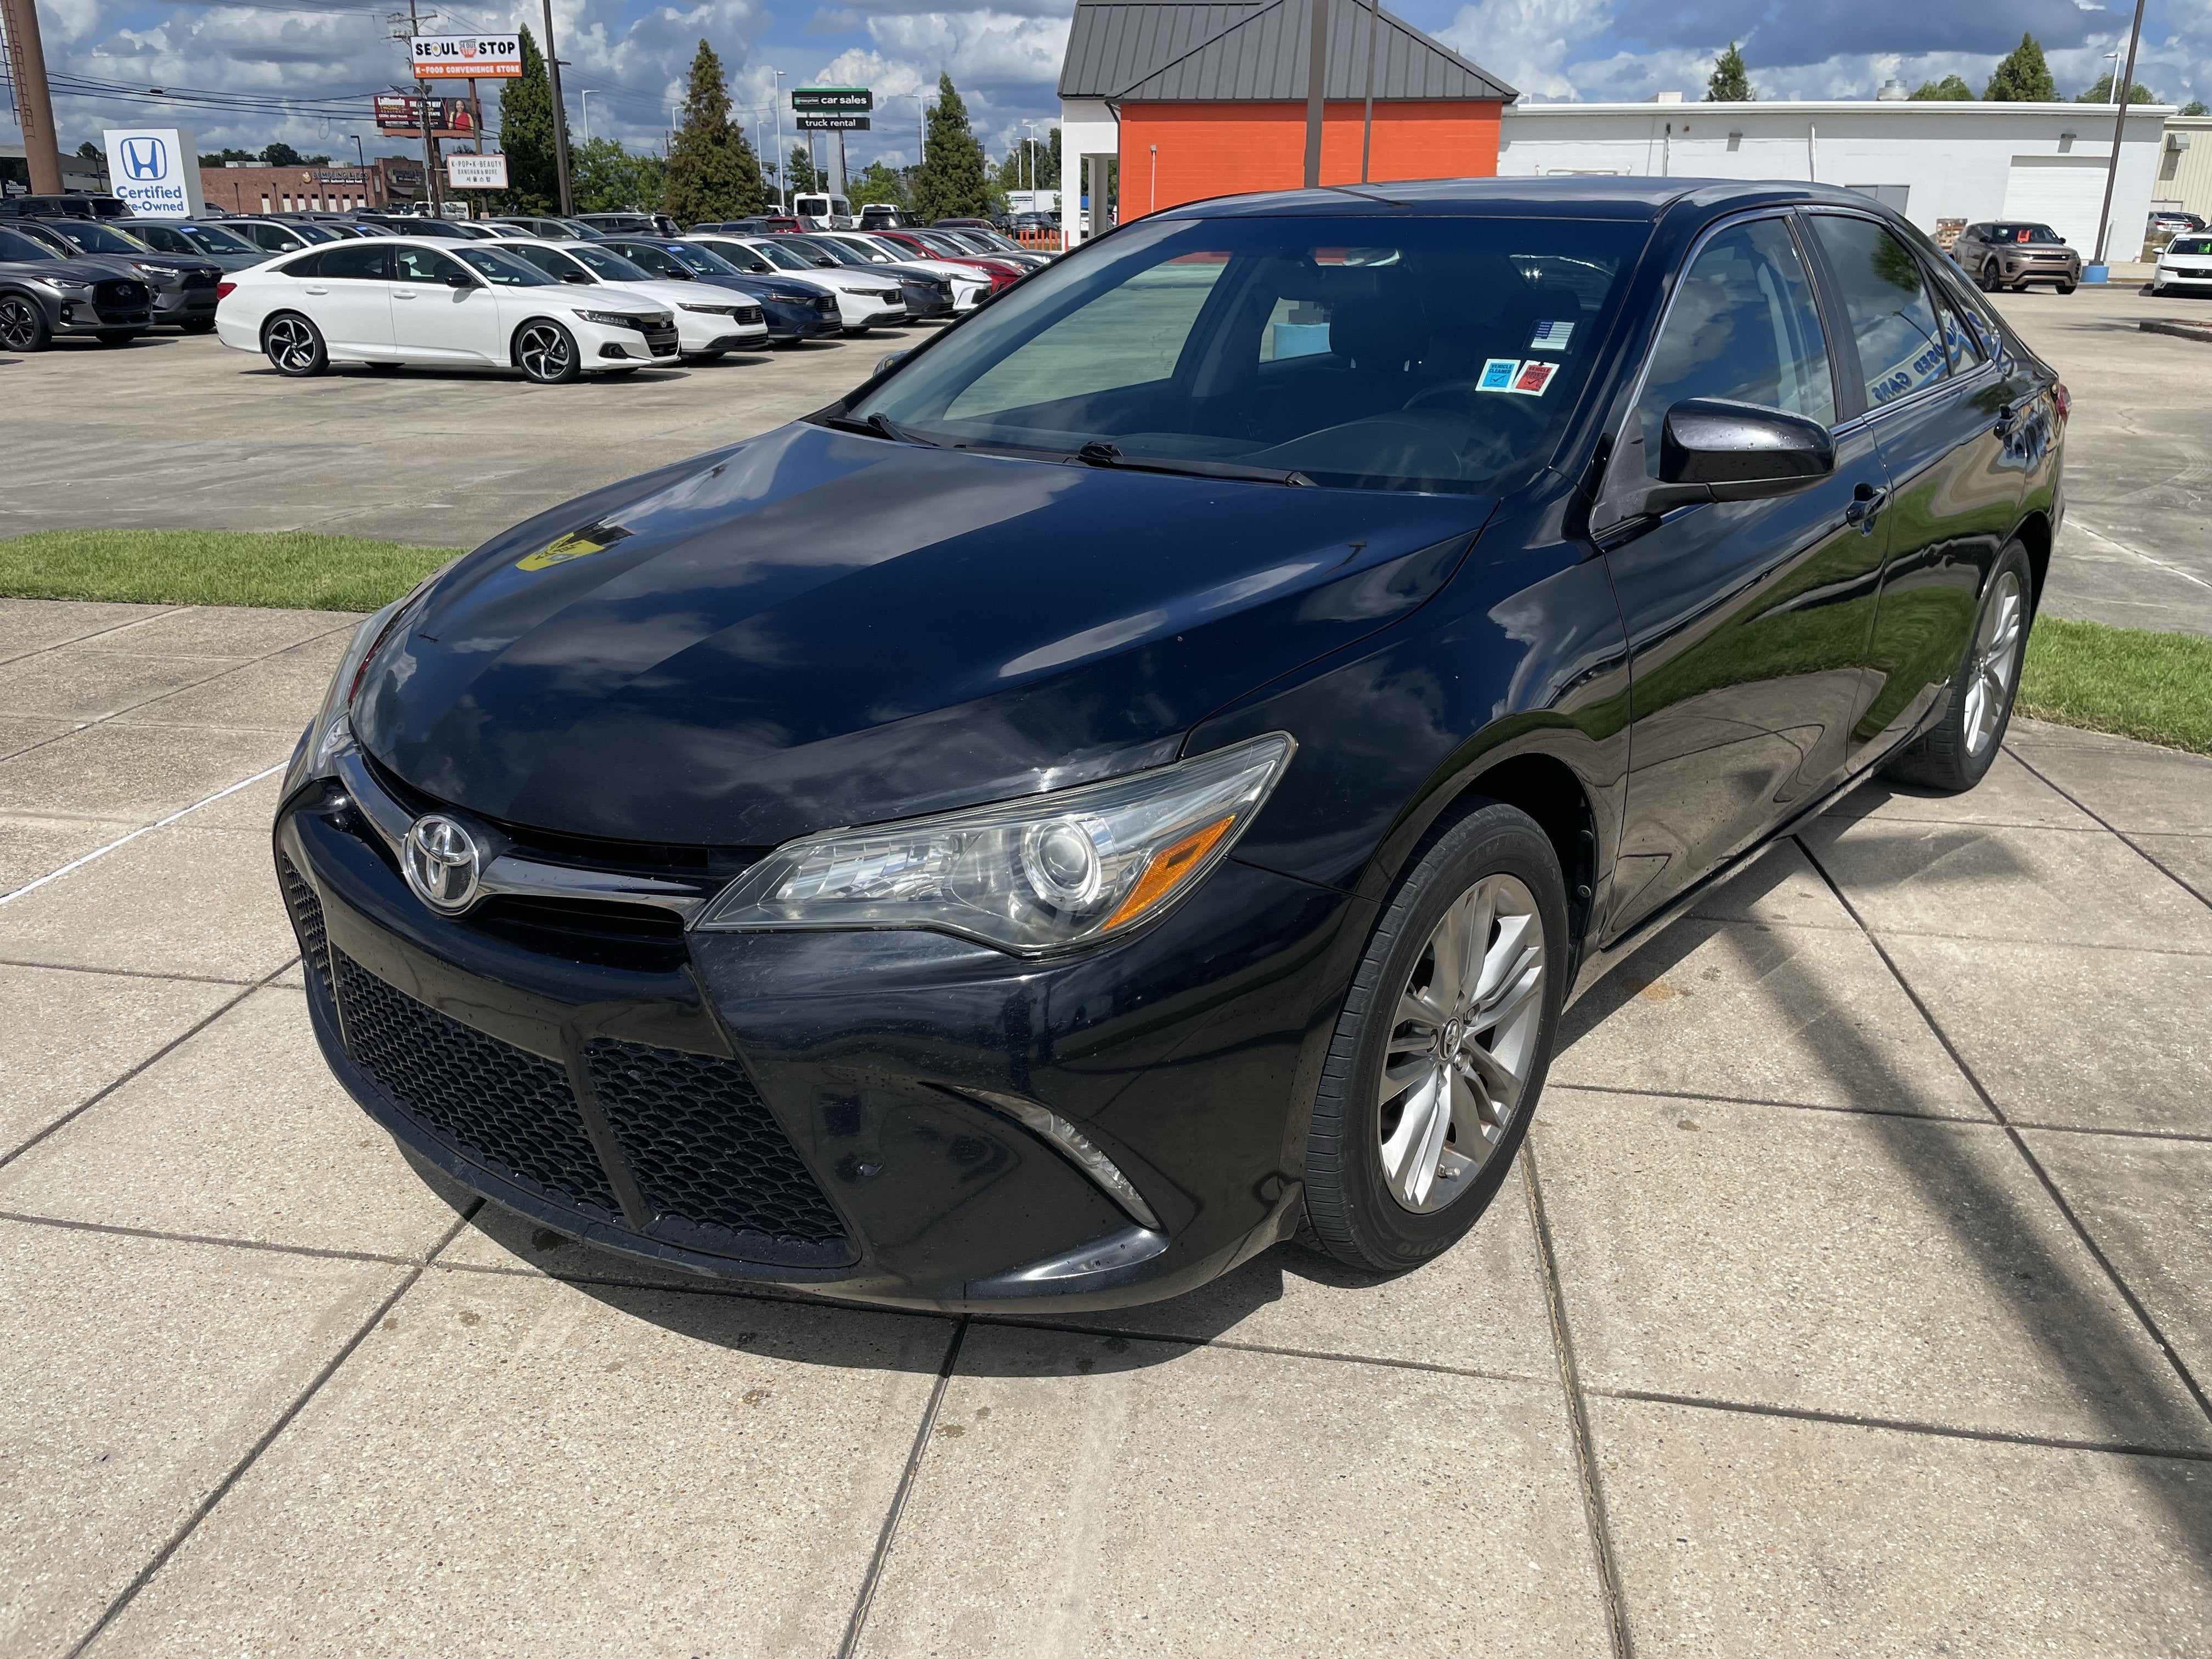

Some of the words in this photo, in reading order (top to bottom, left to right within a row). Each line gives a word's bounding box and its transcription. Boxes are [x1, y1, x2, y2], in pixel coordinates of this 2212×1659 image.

[415, 42, 459, 57] SEOUL
[479, 42, 515, 54] STOP
[416, 66, 444, 74] K-FOOD
[445, 65, 494, 74] CONVENIENCE
[496, 65, 520, 74] STORE
[839, 95, 867, 104] sales
[116, 185, 182, 199] Certified
[128, 200, 184, 211] e-Owned
